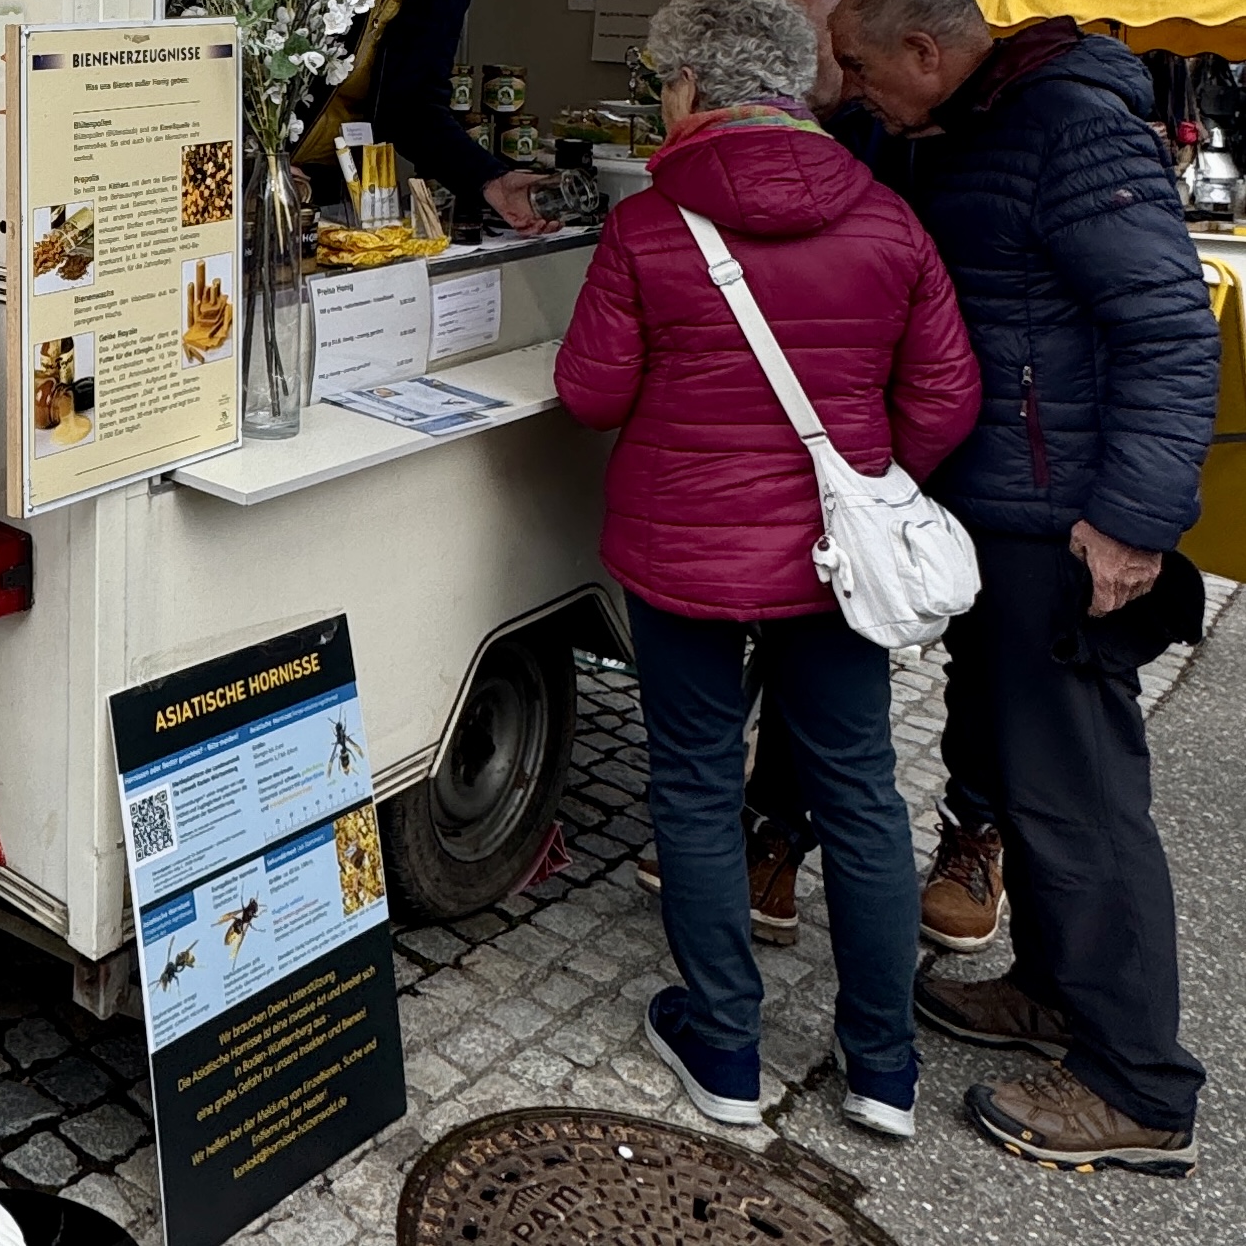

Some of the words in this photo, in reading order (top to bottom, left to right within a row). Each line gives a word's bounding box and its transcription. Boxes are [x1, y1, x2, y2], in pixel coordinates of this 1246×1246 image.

[72, 46, 200, 67] BIENENERZEUGNISSE
[156, 681, 246, 730] ASIATISCHE
[249, 654, 319, 694] HORNISSE
